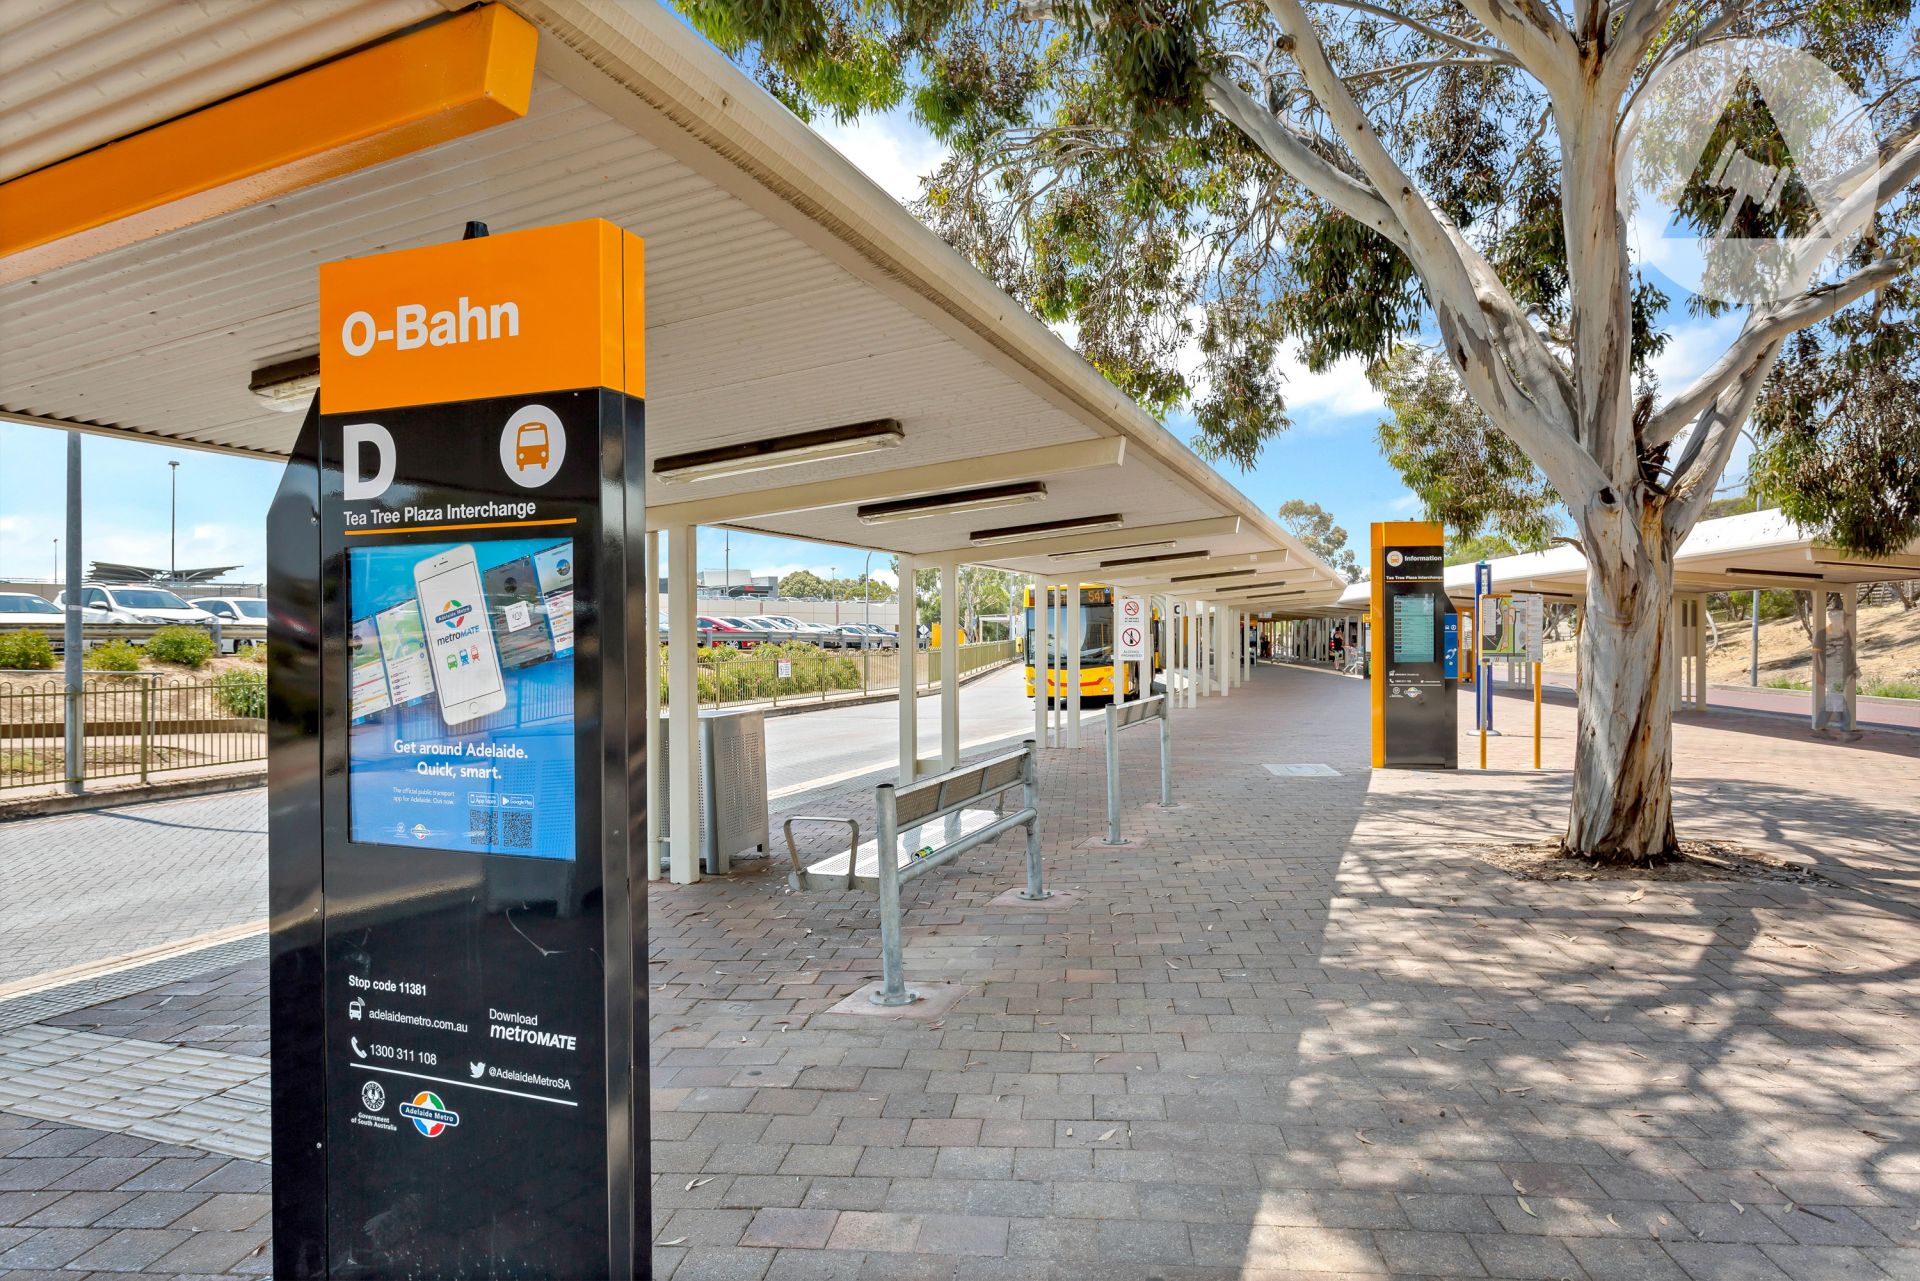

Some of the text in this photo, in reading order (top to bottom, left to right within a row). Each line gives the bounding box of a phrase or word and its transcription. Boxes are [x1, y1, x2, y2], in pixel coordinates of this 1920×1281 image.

[341, 296, 519, 357] O-Bahn
[343, 423, 397, 501] D
[343, 501, 536, 526] Tea Tree Plaza Interchange
[1088, 590, 1105, 603] 541
[437, 625, 480, 646] metroMATE
[394, 739, 528, 759] Get around Adelaide.
[417, 761, 502, 780] Quick, smart.
[349, 975, 427, 996] Stop code 11381
[369, 1008, 468, 1033] adelaidemetro.com.au
[489, 1008, 538, 1026] Download
[490, 1024, 577, 1050] metroMATE
[370, 1044, 437, 1066] 1300 311 108
[488, 1066, 571, 1090] @AdelaideMetroSA
[358, 1112, 390, 1124] Government
[358, 1118, 373, 1127] South
[374, 1120, 397, 1132] Australia
[405, 1107, 454, 1122] Adelaide Metro
